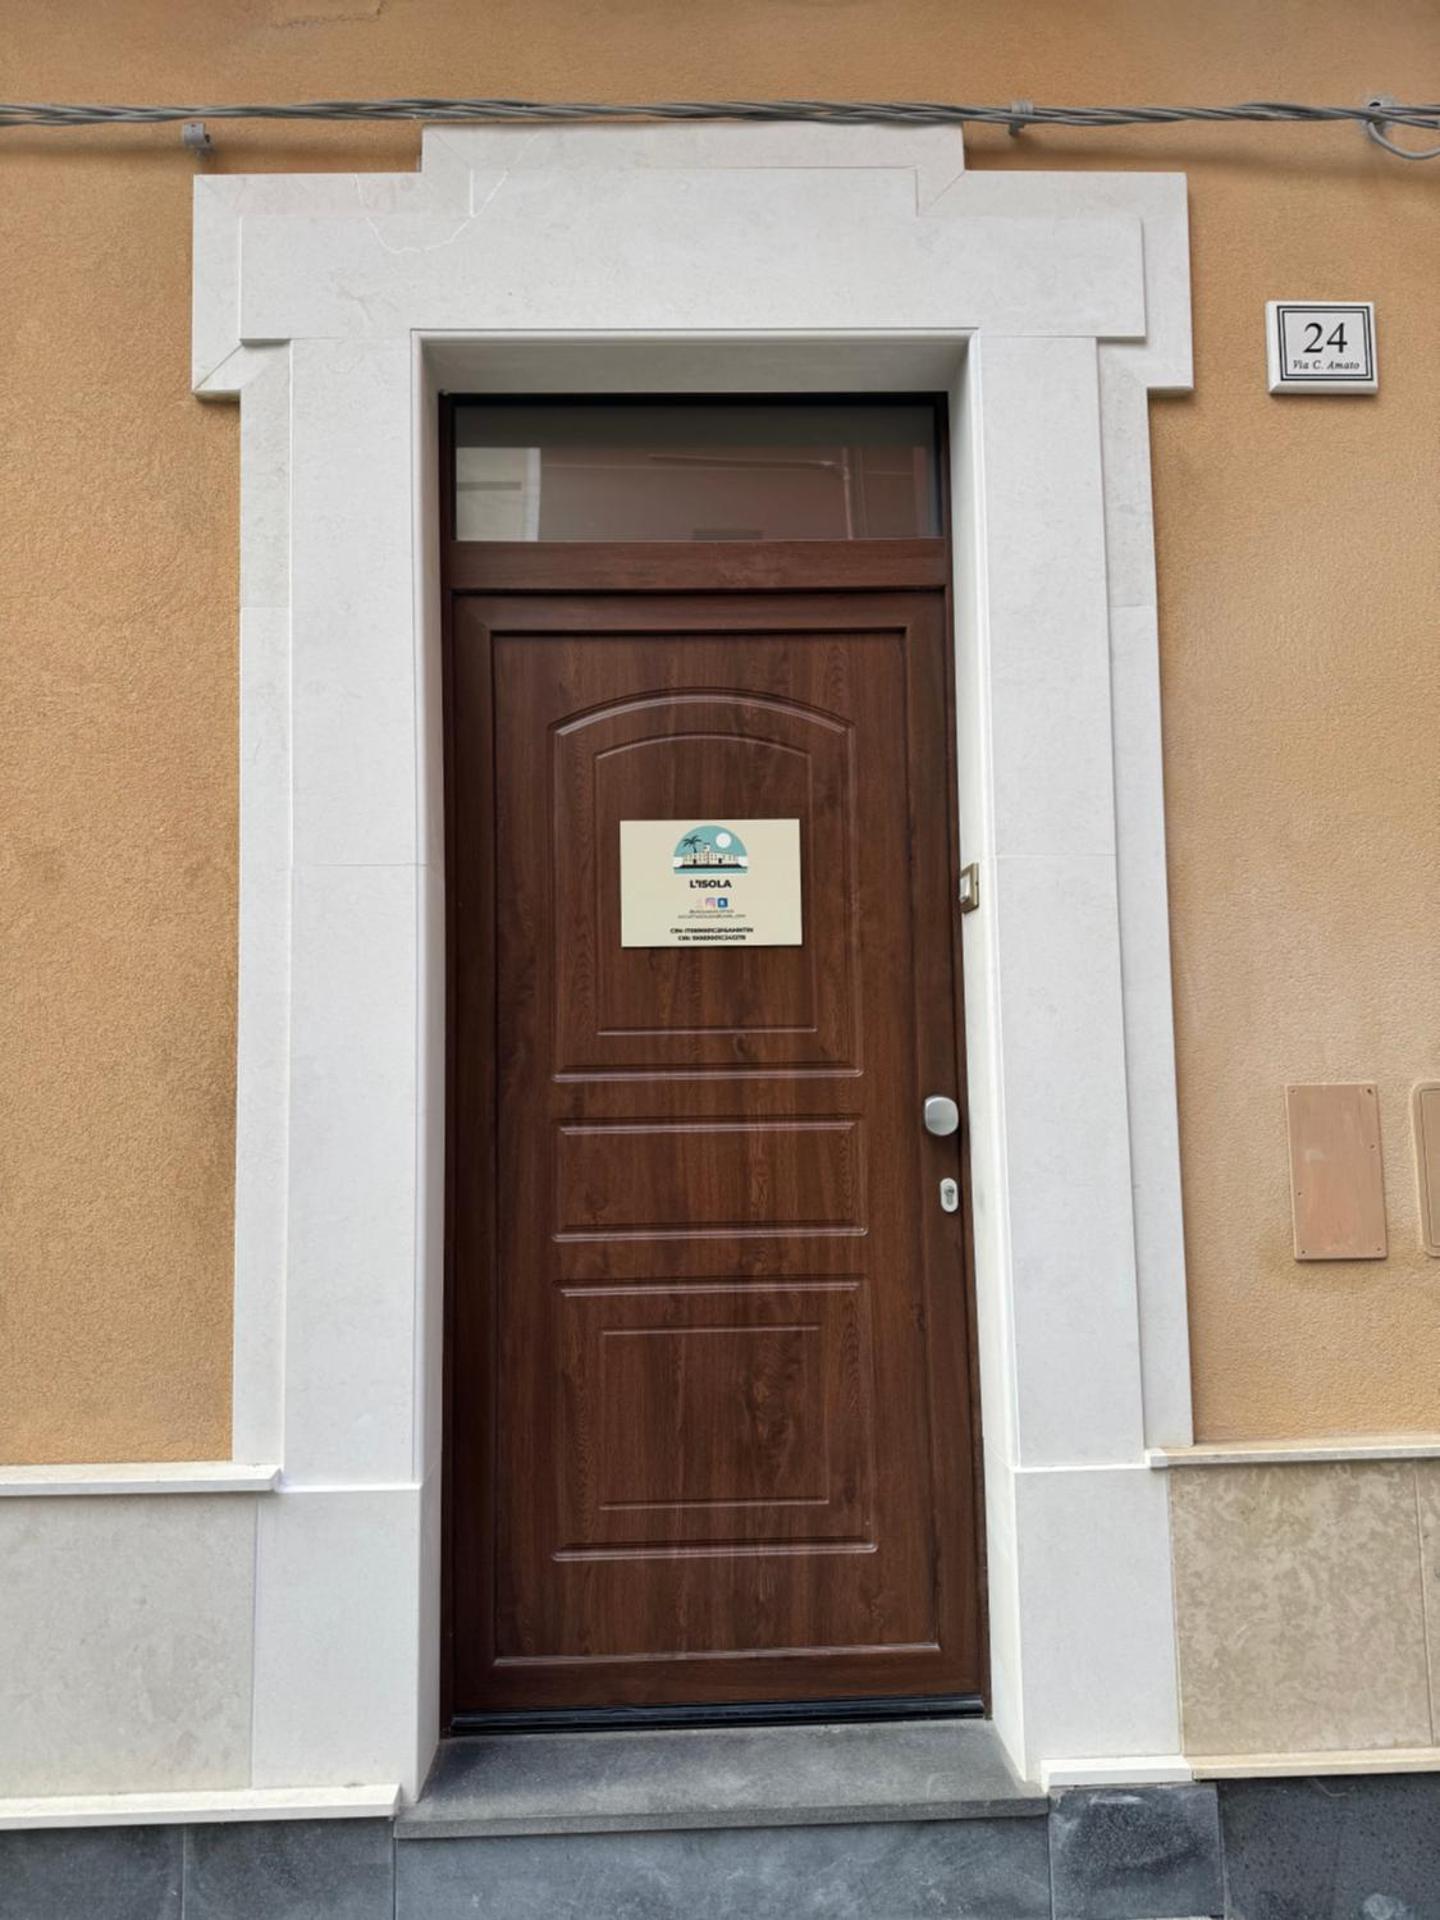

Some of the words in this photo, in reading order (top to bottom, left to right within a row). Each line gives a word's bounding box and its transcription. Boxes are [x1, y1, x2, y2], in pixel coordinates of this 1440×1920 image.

[1303, 322, 1348, 353] 24
[1293, 360, 1309, 369] Via
[1312, 360, 1324, 370] C.
[1327, 361, 1360, 370] Amato
[689, 879, 732, 889] L'ISOLA
